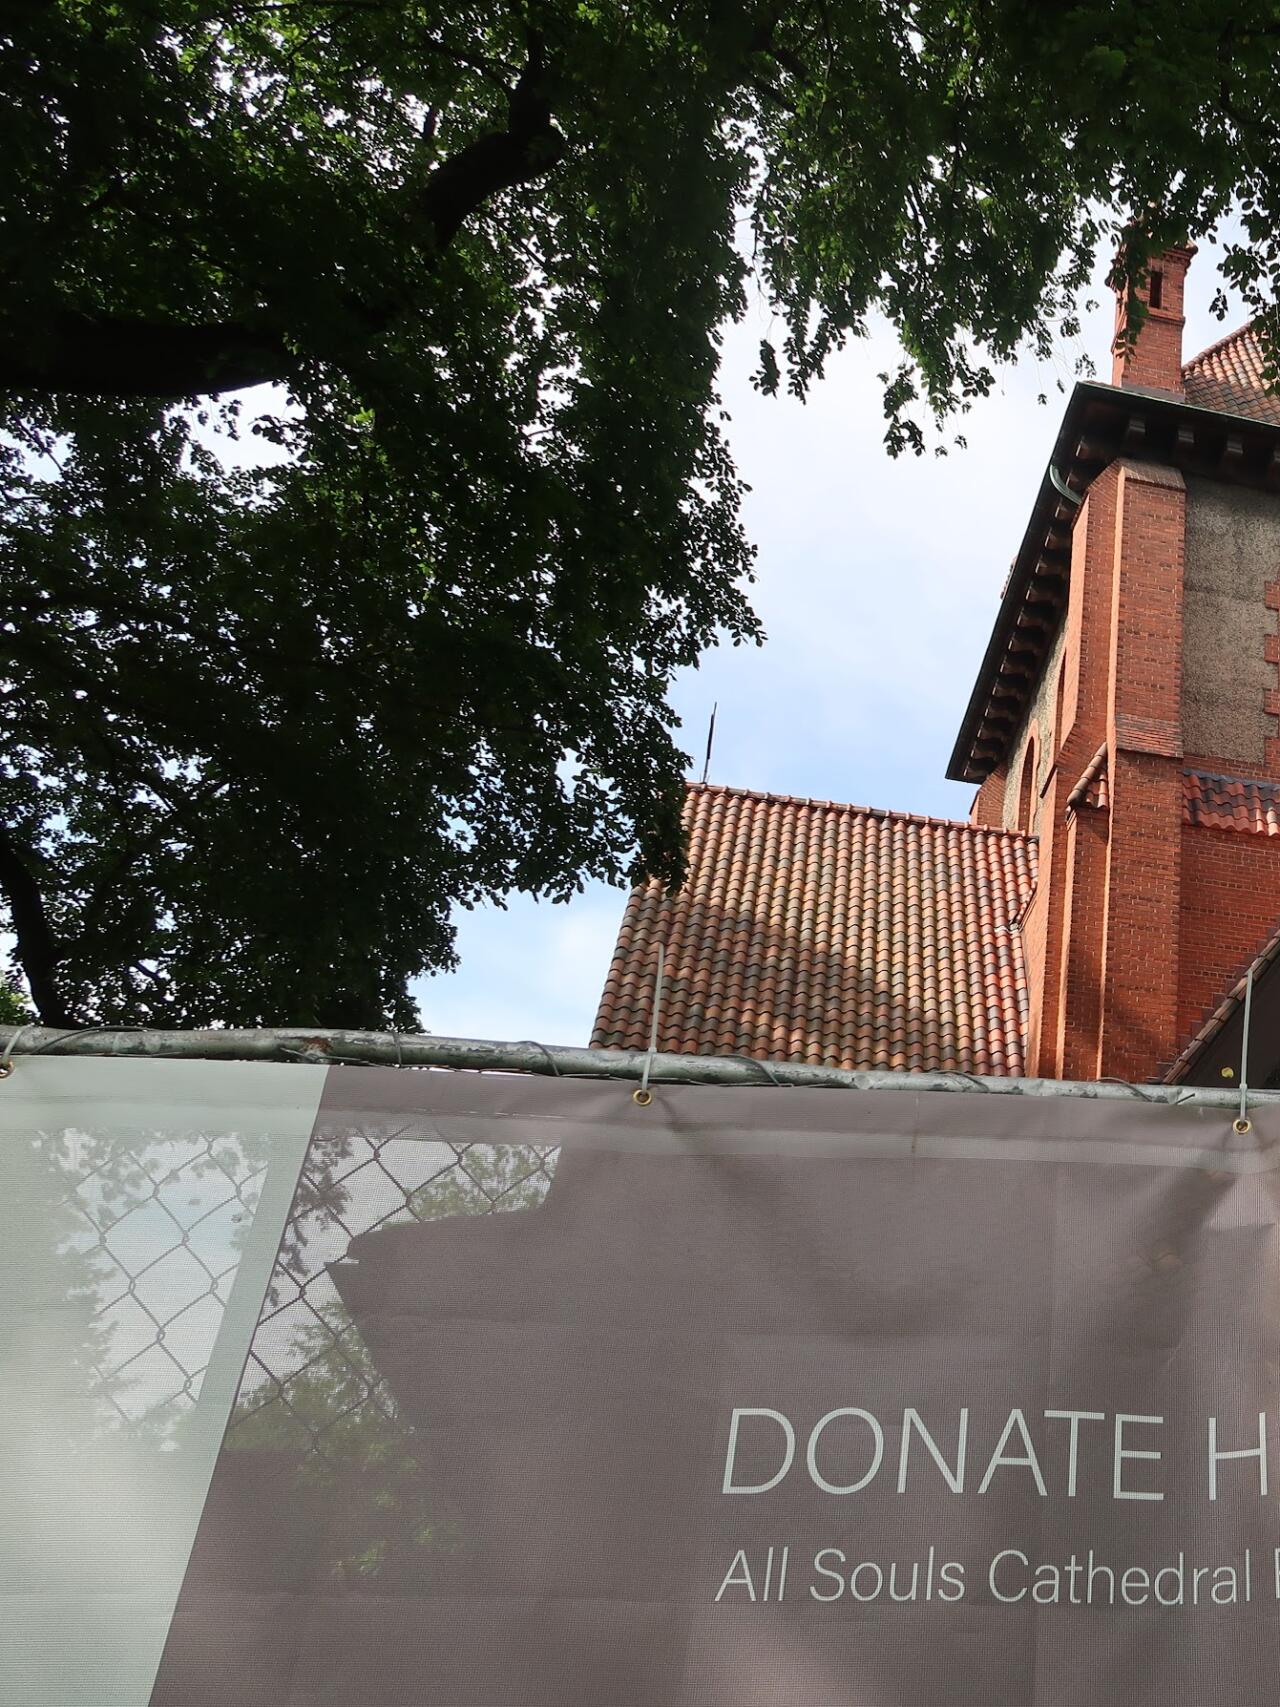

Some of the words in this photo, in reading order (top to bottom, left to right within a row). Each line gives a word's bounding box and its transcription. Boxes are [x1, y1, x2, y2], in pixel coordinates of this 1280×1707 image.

[721, 1406, 1164, 1502] DONATE
[713, 1546, 790, 1602] All
[808, 1546, 966, 1603] Souls
[987, 1548, 1252, 1606] Cathedral
